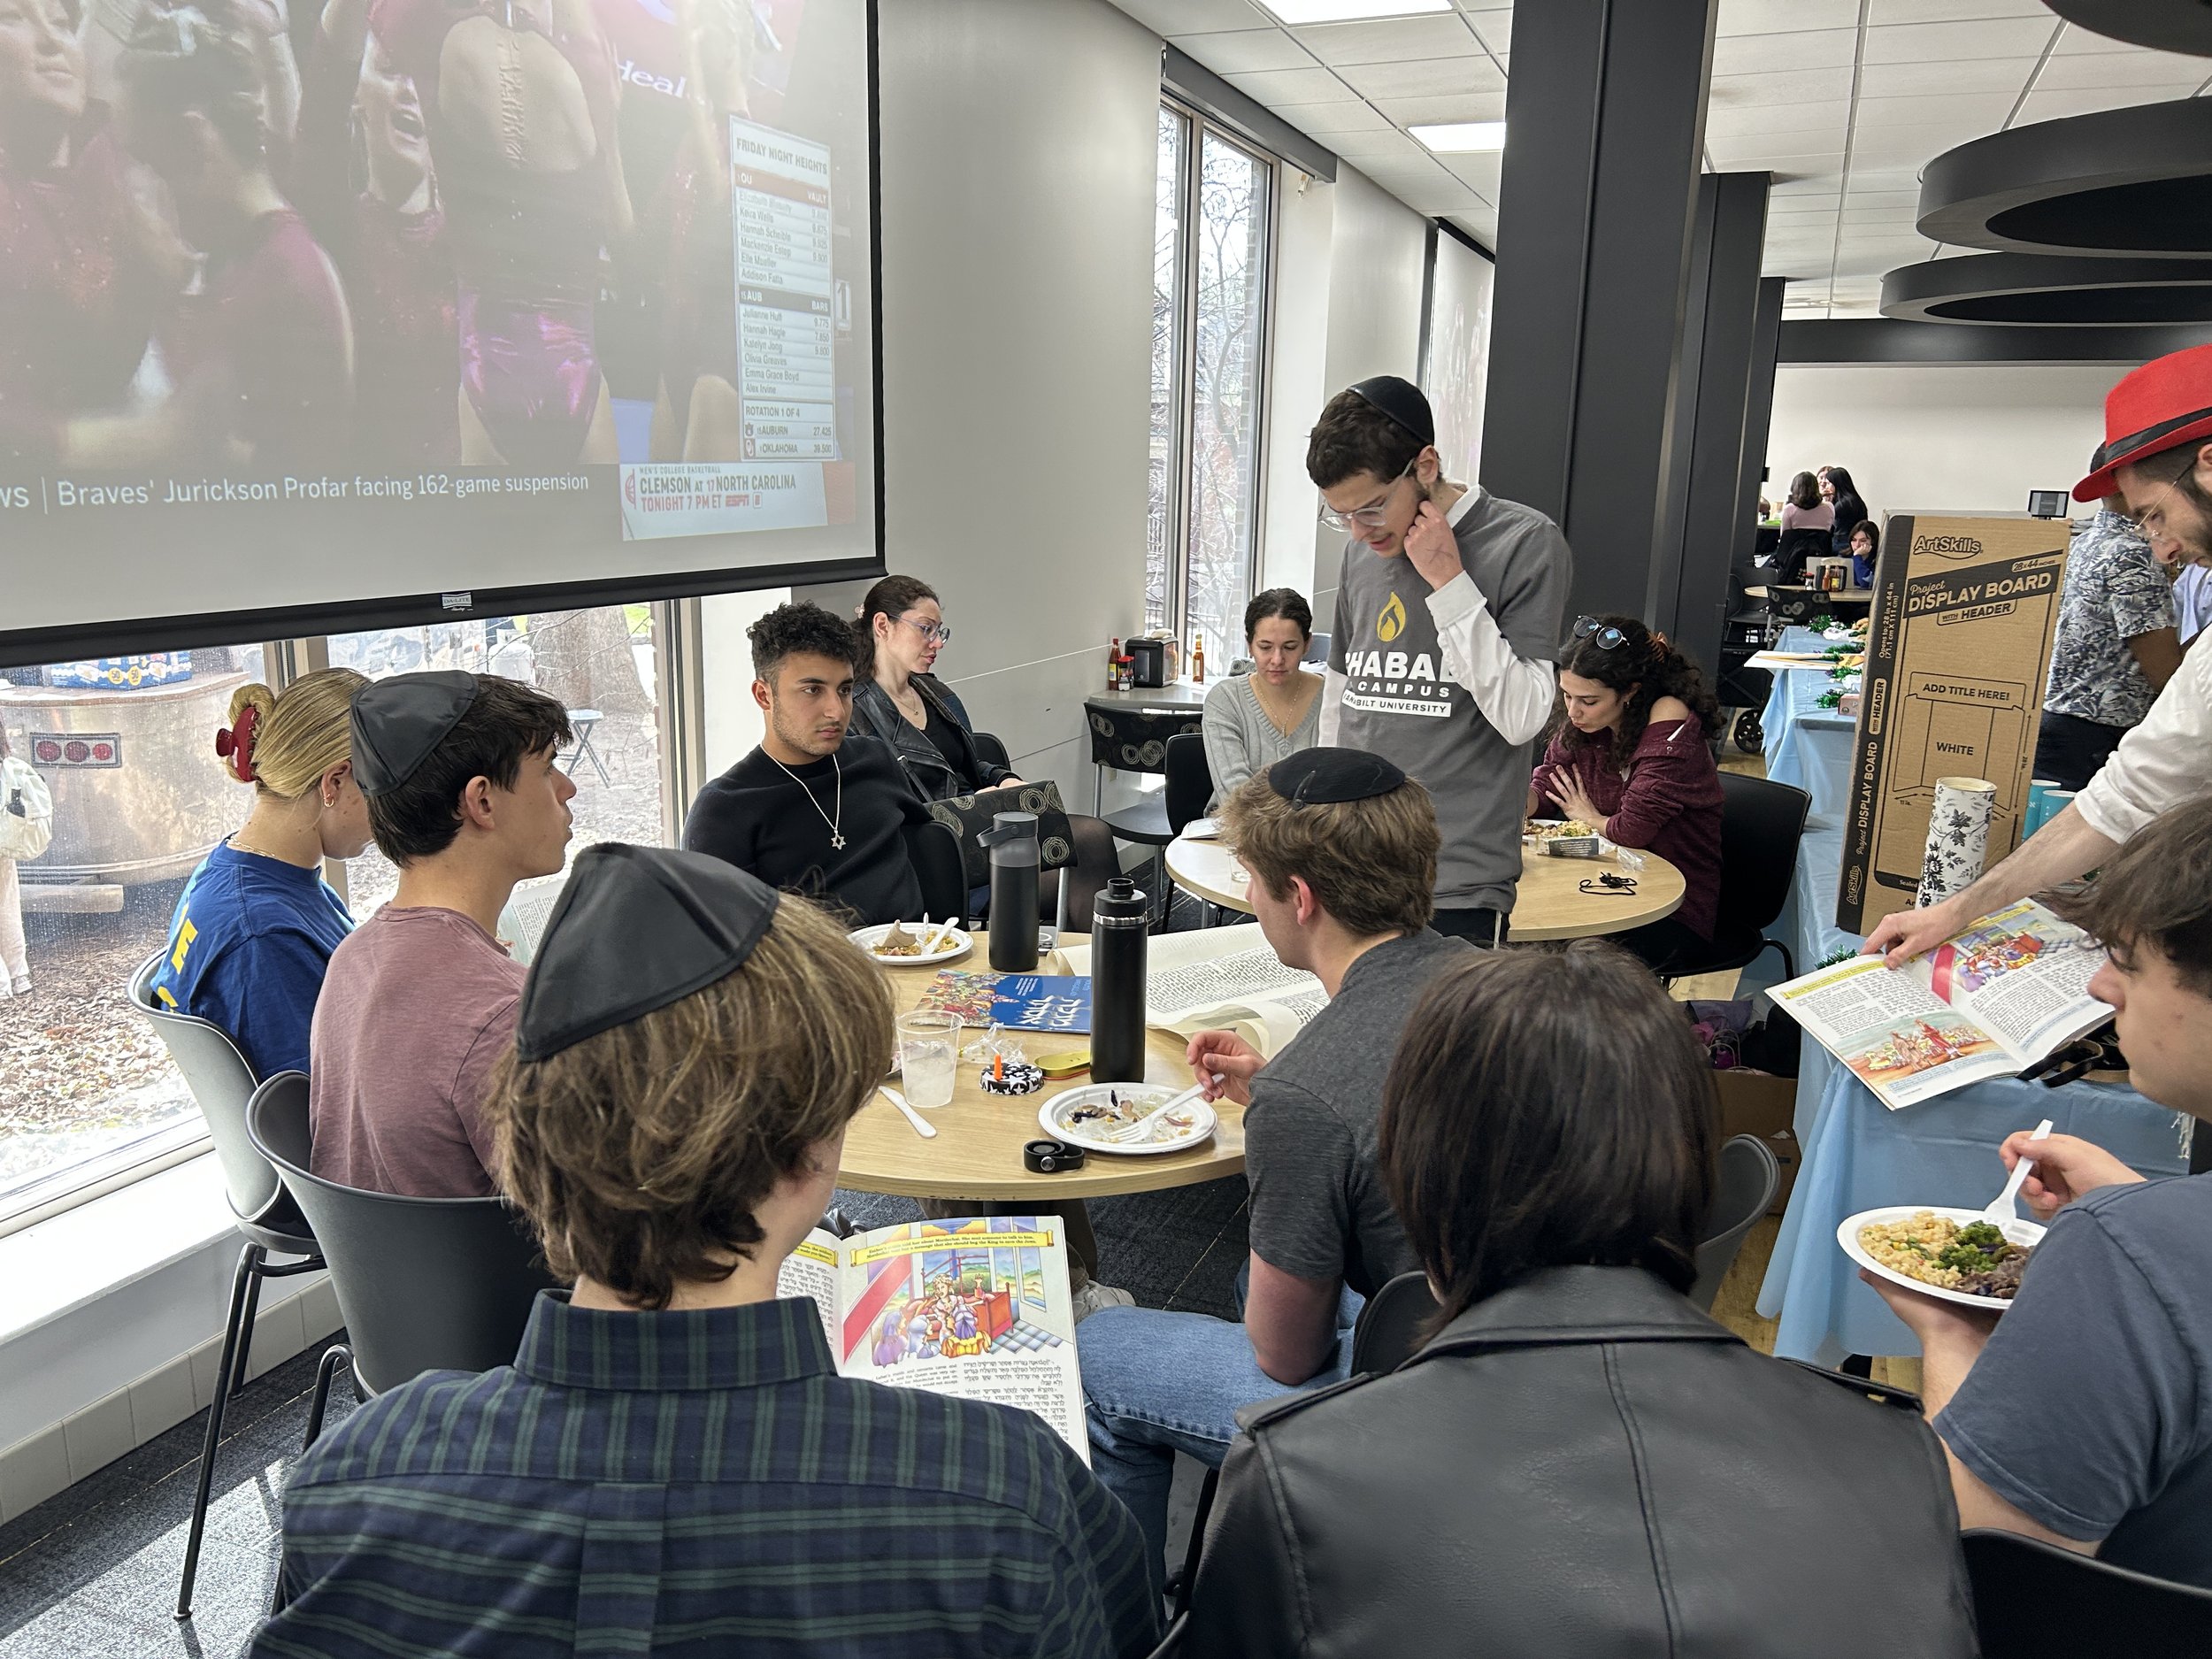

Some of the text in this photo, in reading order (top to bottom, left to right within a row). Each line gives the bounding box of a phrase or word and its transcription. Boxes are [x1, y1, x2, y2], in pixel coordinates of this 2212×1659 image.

[736, 137, 827, 175] FRIDAY NIGHT HEIGHTS
[741, 173, 753, 185] OU
[807, 190, 826, 204] VAULT
[740, 221, 764, 235] Hannah
[741, 268, 767, 282] Addison
[747, 290, 763, 302] AUB
[811, 301, 828, 312] BARS
[743, 324, 768, 336] Hannah
[814, 318, 829, 329] 9.775
[743, 338, 767, 352] Katelyn
[745, 353, 787, 366] Olivia Greaves
[745, 368, 799, 382] Emma Grace Boyd
[745, 382, 777, 395] Alex Irvine
[745, 405, 780, 417] ROTATION
[786, 406, 795, 418] OF
[762, 426, 788, 436] AUBURN
[813, 426, 832, 436] 27.425
[762, 443, 832, 454] OKLAHOMA 39.500
[639, 465, 721, 475] MEN'S COLLEGE BASKETBALL
[57, 480, 155, 507] Braves'
[163, 478, 279, 503] Jurickson
[283, 476, 349, 500] Profar
[355, 475, 414, 500] facing
[417, 474, 501, 498] 162-game
[505, 472, 589, 495] suspension
[640, 476, 691, 495] CLEMSON
[695, 480, 703, 492] AT
[716, 475, 749, 491] NORTH
[752, 474, 796, 490] CAROLINA
[641, 495, 684, 512] TONIGHT
[687, 495, 693, 511] 7
[695, 495, 710, 510] PM
[712, 494, 722, 509] ET
[725, 494, 749, 508] ESPN
[1914, 535, 1982, 555] ArtSkills
[1909, 580, 1947, 596] Project
[1909, 572, 2052, 612] DISPLAY BOARD
[1961, 603, 2011, 620] HEADER
[1878, 636, 1888, 658] Opens
[1345, 650, 1455, 683] HABA
[1357, 680, 1450, 698] CAMPUS
[1923, 683, 2009, 701] ADD TITLE HERE!
[1379, 701, 1447, 713] UNIVERSITY
[1872, 681, 1885, 718] HEADER
[1936, 741, 1974, 756] WHITE
[1856, 741, 1878, 856] Project DISPLAY BOARD
[1847, 865, 1860, 904] ArtSkills
